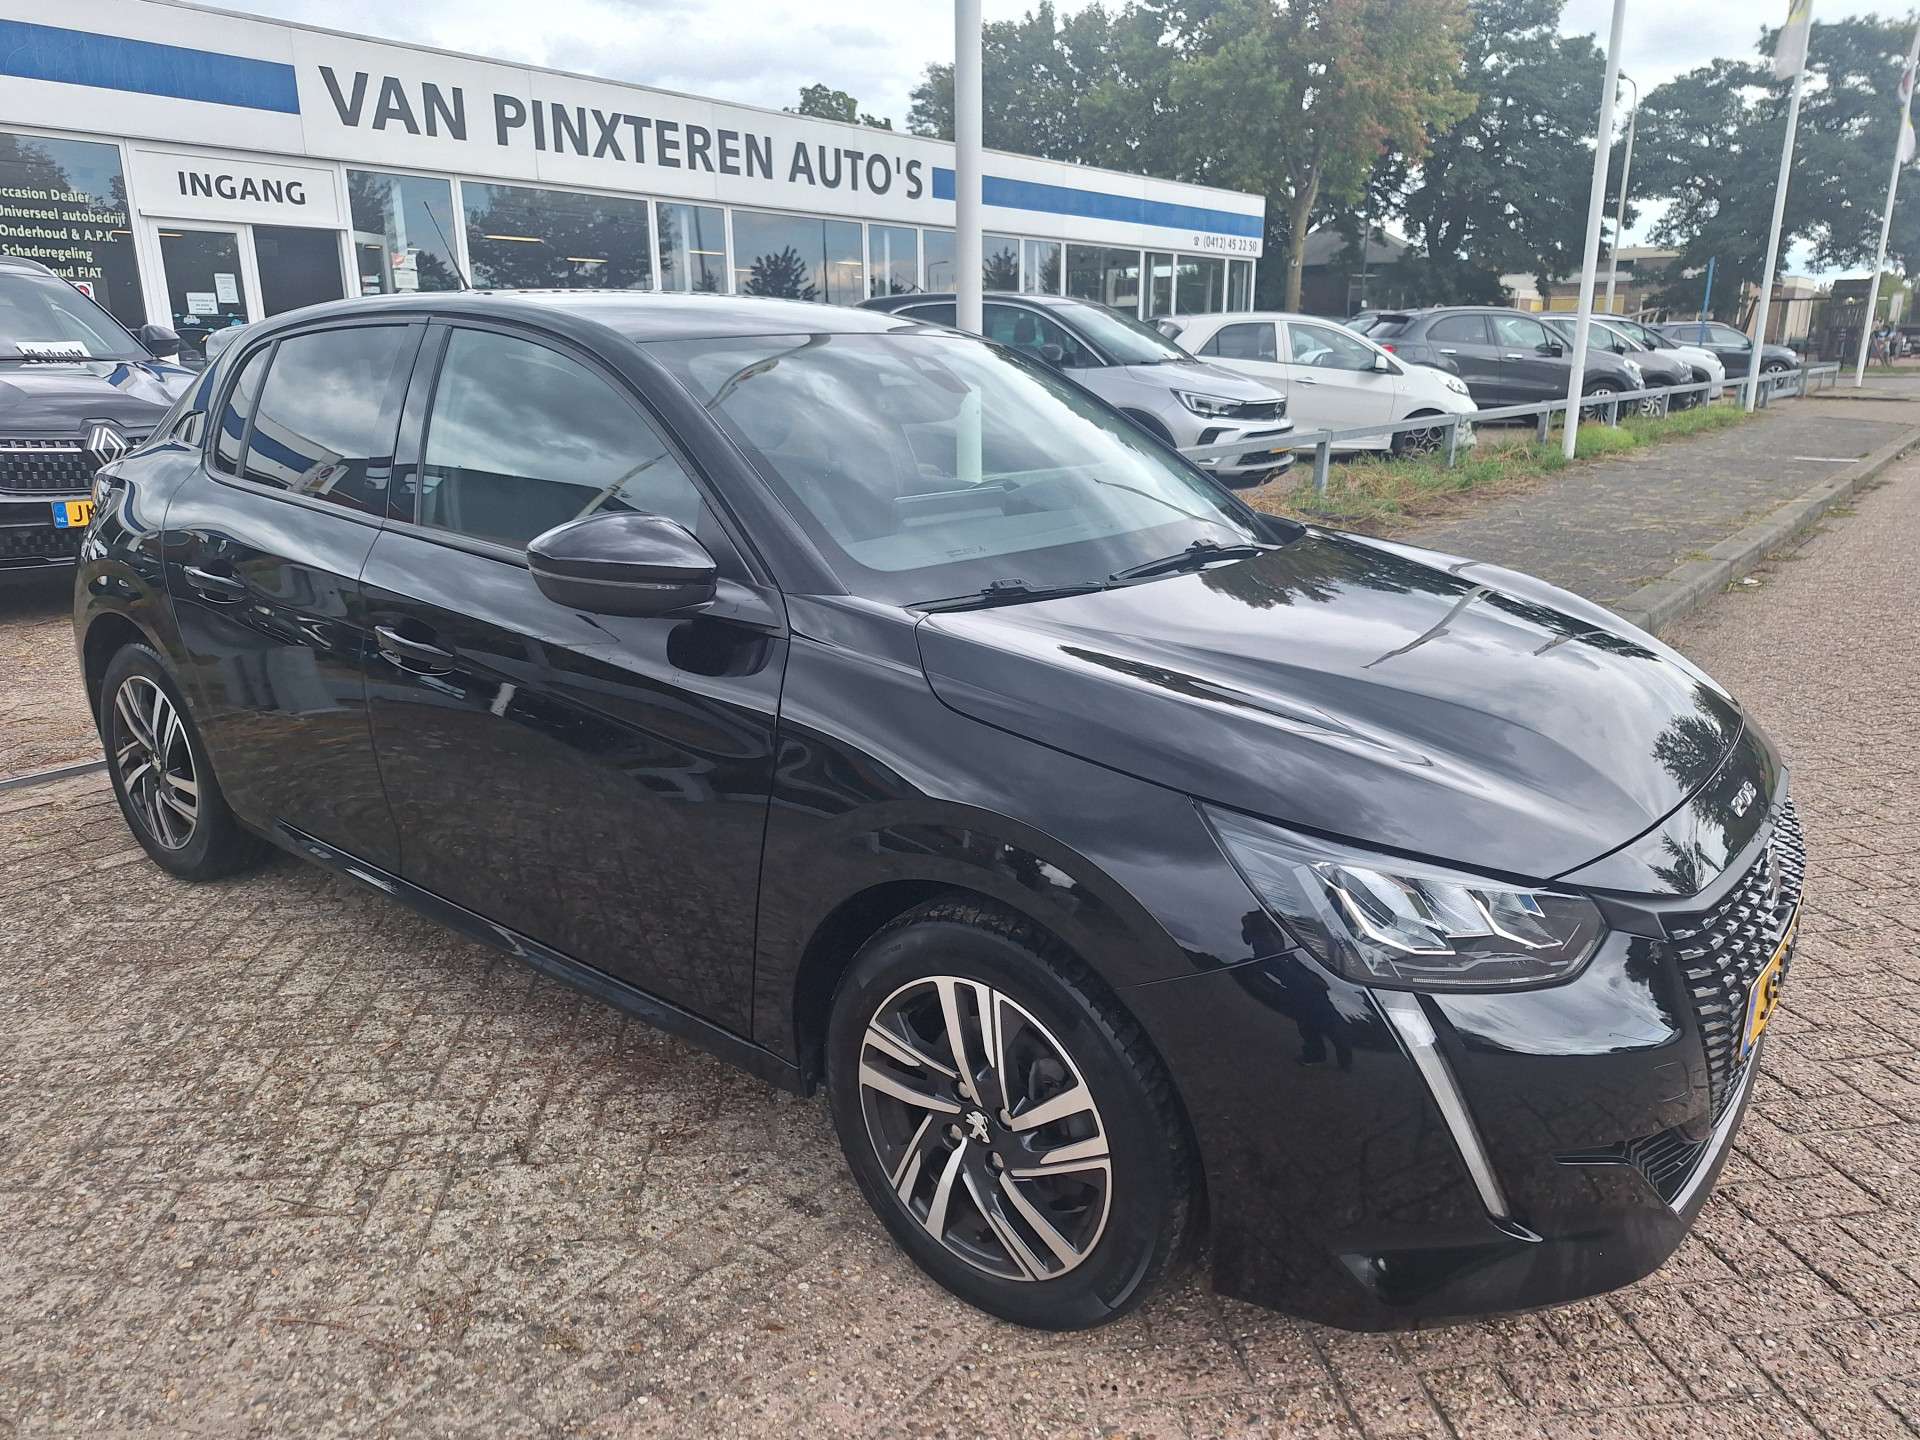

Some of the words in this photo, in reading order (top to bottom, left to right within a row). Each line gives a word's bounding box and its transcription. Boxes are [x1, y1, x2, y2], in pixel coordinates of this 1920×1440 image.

[318, 65, 467, 141] VAN
[493, 93, 774, 181] PINXTEREN
[788, 141, 924, 200] AUTO'S
[0, 187, 47, 200] ccasion
[50, 189, 90, 203] Dealer
[177, 170, 306, 205] INGANG
[62, 210, 126, 228] autobedrijf
[0, 223, 67, 240] Onderhoud
[71, 228, 80, 240] &
[84, 229, 118, 242] A.P.K.
[1203, 234, 1226, 248] (0412)
[1227, 238, 1236, 250] 45
[1238, 239, 1247, 251] 22
[2, 243, 94, 263] Schaderegeling
[78, 266, 102, 279] FIAT
